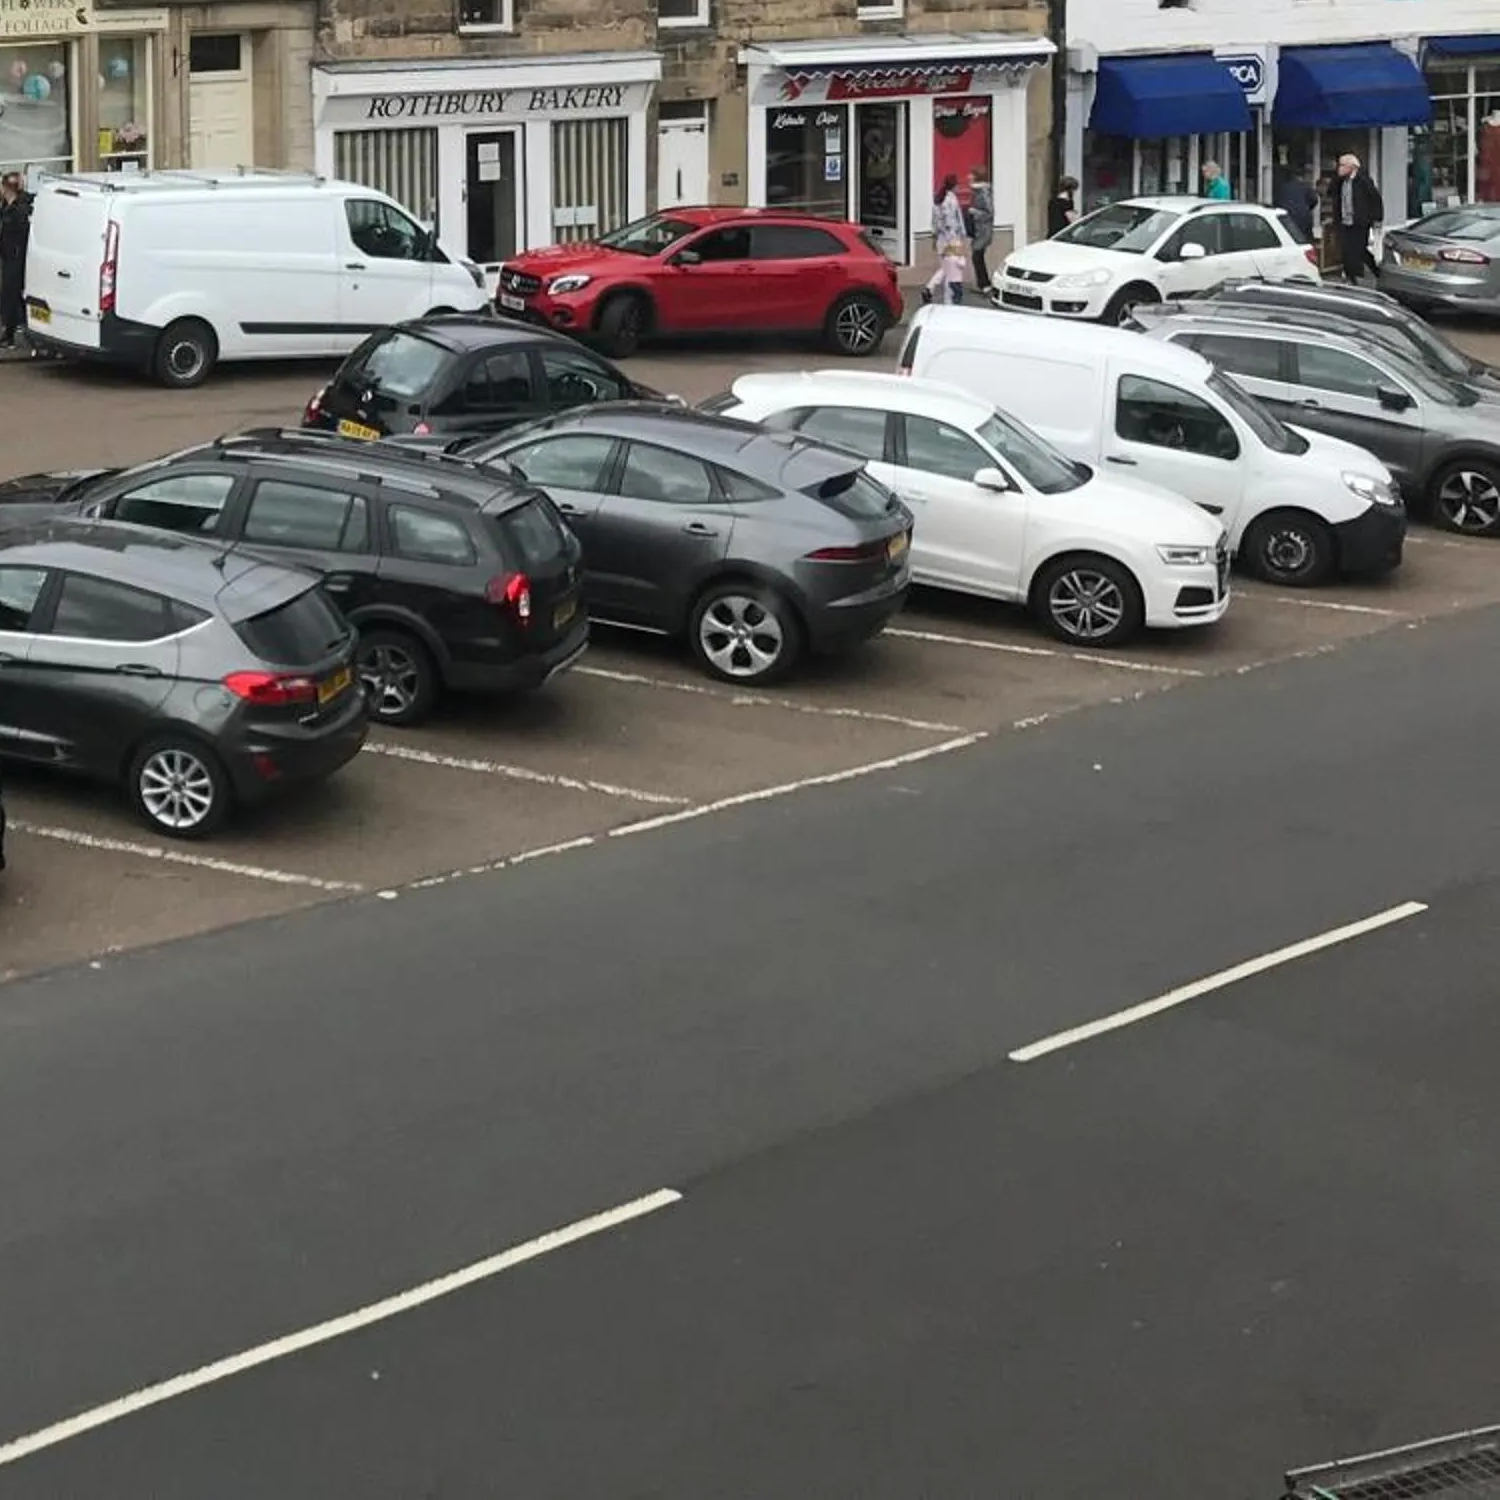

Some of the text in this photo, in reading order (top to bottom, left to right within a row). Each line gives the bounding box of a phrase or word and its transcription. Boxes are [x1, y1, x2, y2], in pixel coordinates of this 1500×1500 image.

[4, 18, 71, 34] FOLIAGE
[366, 85, 629, 119] ROTHBURY BAKERY
